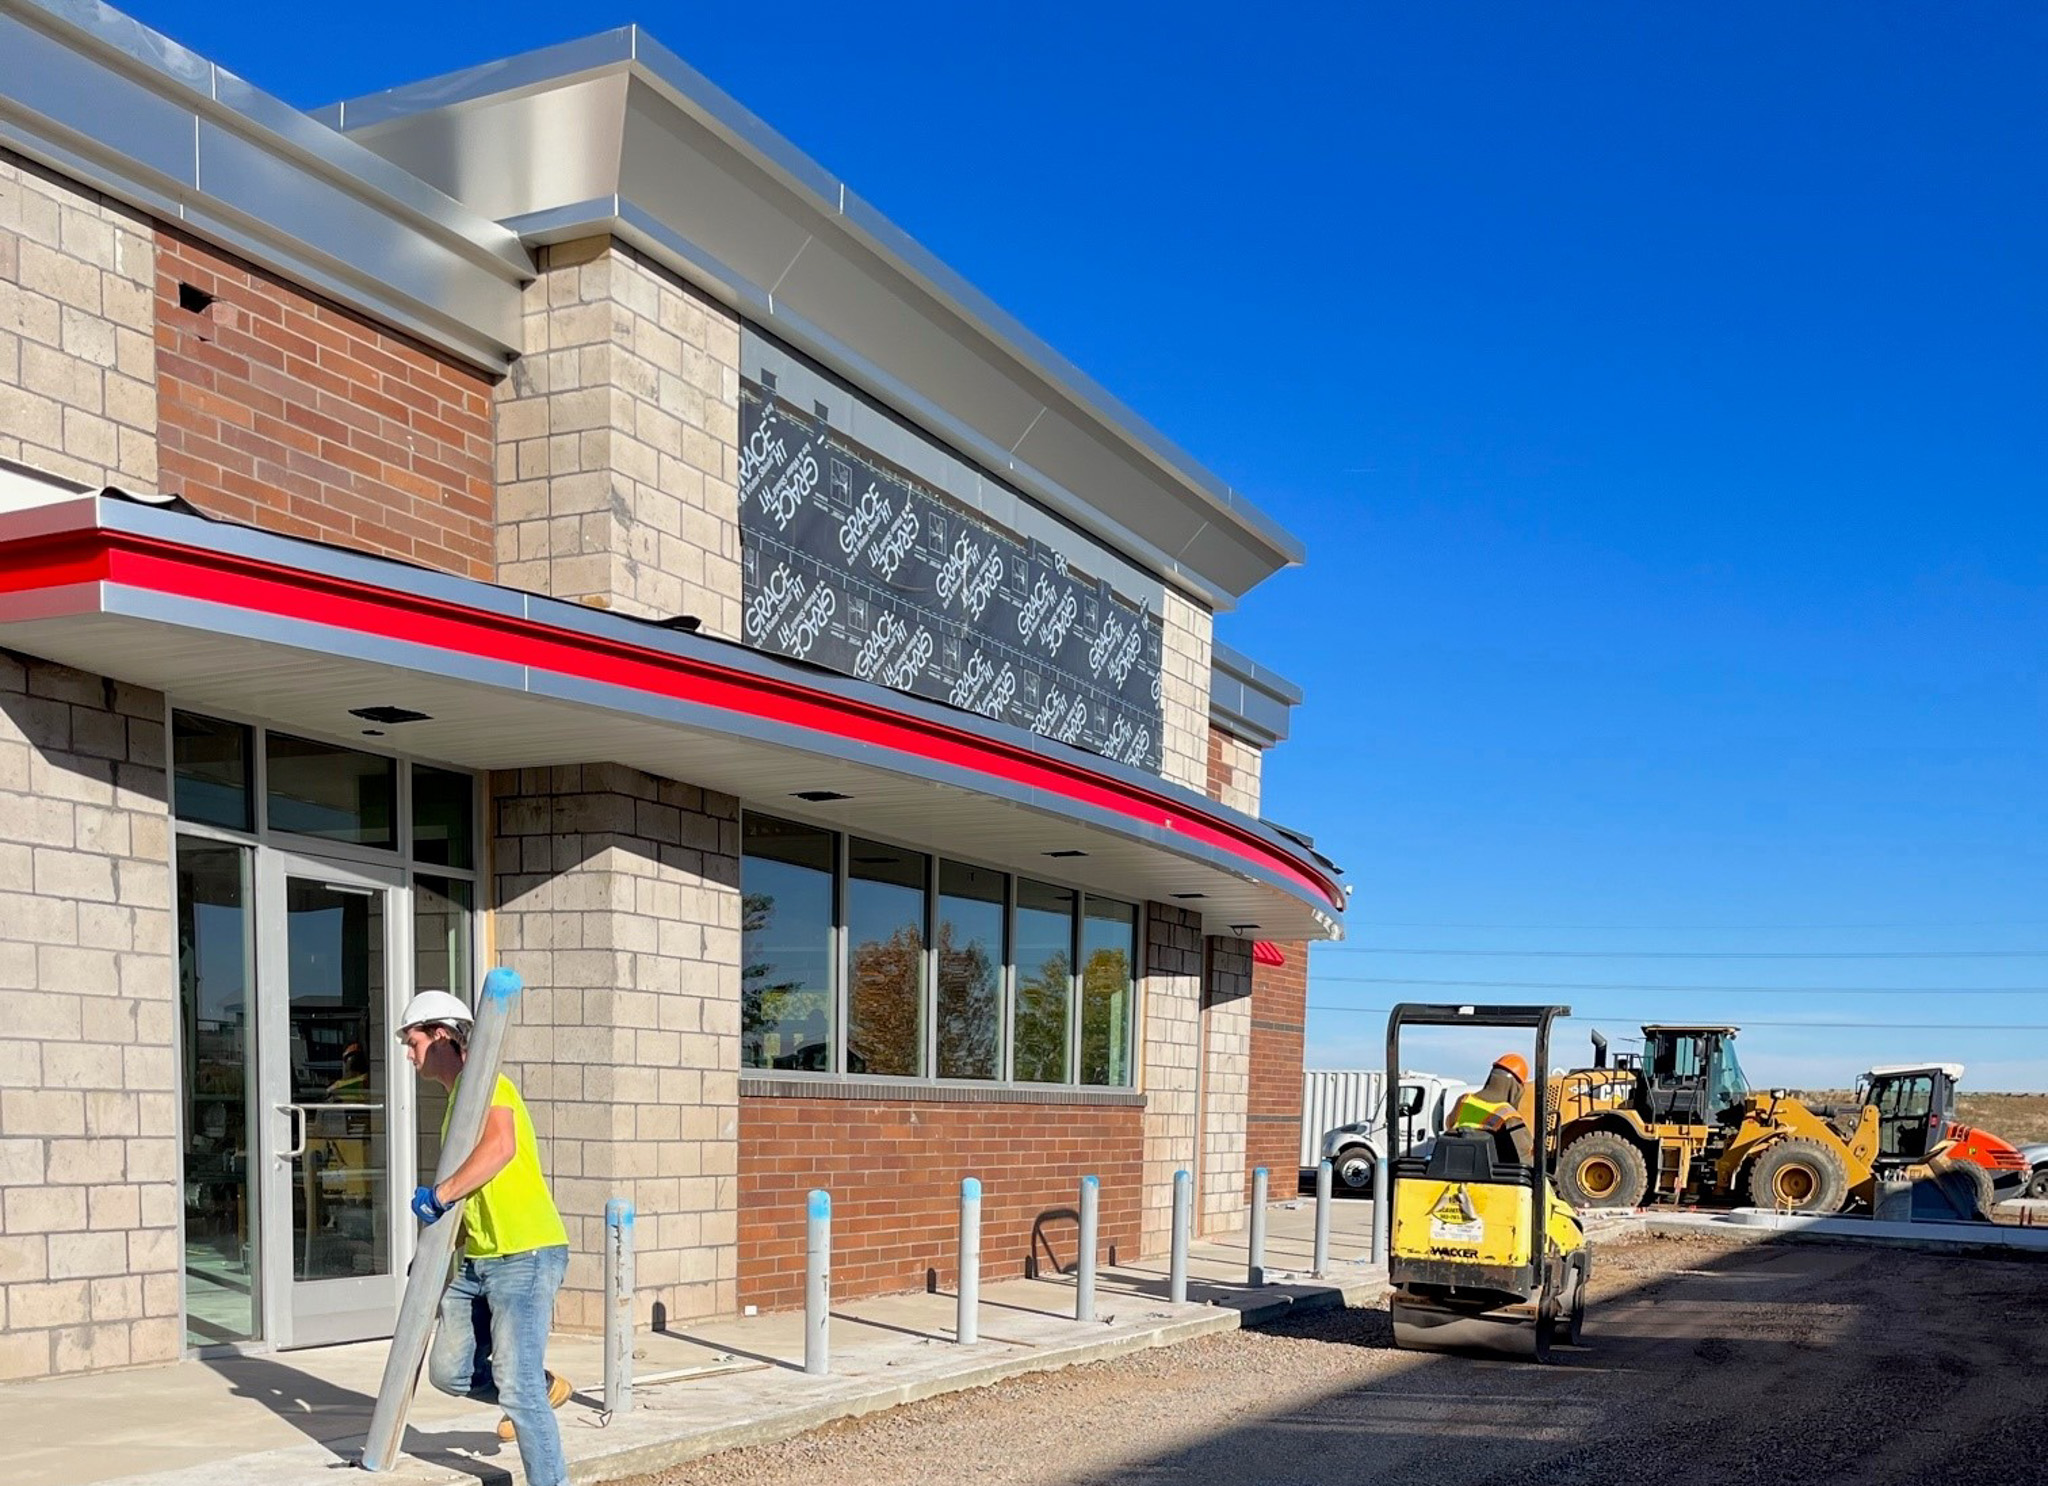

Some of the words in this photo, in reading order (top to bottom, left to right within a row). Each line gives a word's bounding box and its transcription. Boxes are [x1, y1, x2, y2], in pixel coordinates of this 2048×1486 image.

[737, 420, 775, 486] RACE
[771, 456, 818, 531] GRACE
[840, 482, 882, 553] GRACE
[878, 513, 919, 582] GRACE
[936, 529, 972, 597] GRACE
[745, 562, 794, 637] GRACE
[968, 556, 1003, 622] GRACE
[1018, 572, 1050, 634] GRACE
[790, 588, 836, 659] GRACE
[857, 610, 897, 676] GRACE
[1601, 1084, 1631, 1101] CAT
[1430, 1246, 1478, 1258] WACKER
